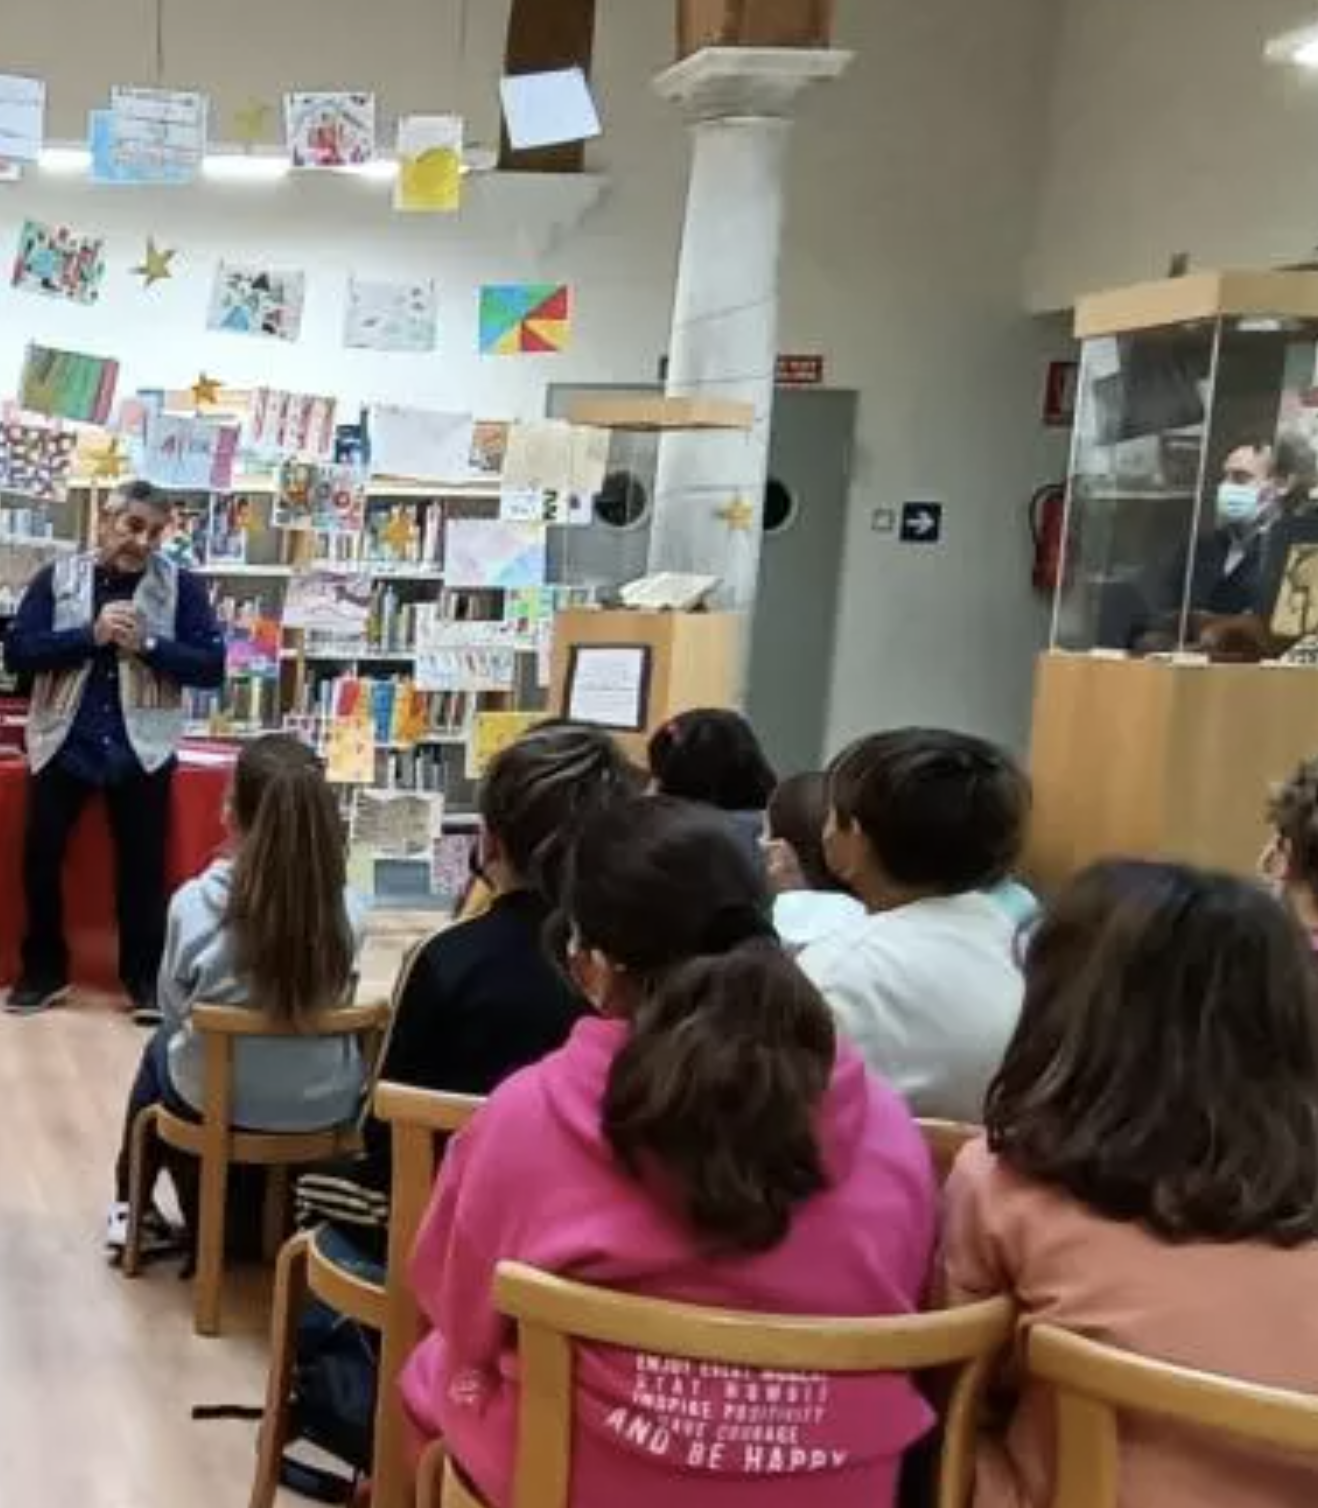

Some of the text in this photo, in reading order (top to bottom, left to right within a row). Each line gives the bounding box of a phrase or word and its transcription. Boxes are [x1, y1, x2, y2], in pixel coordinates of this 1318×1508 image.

[633, 1390, 713, 1419] INSPIRE
[604, 1407, 850, 1473] AND BE HAPPY
[716, 1424, 799, 1444] COURAGE
